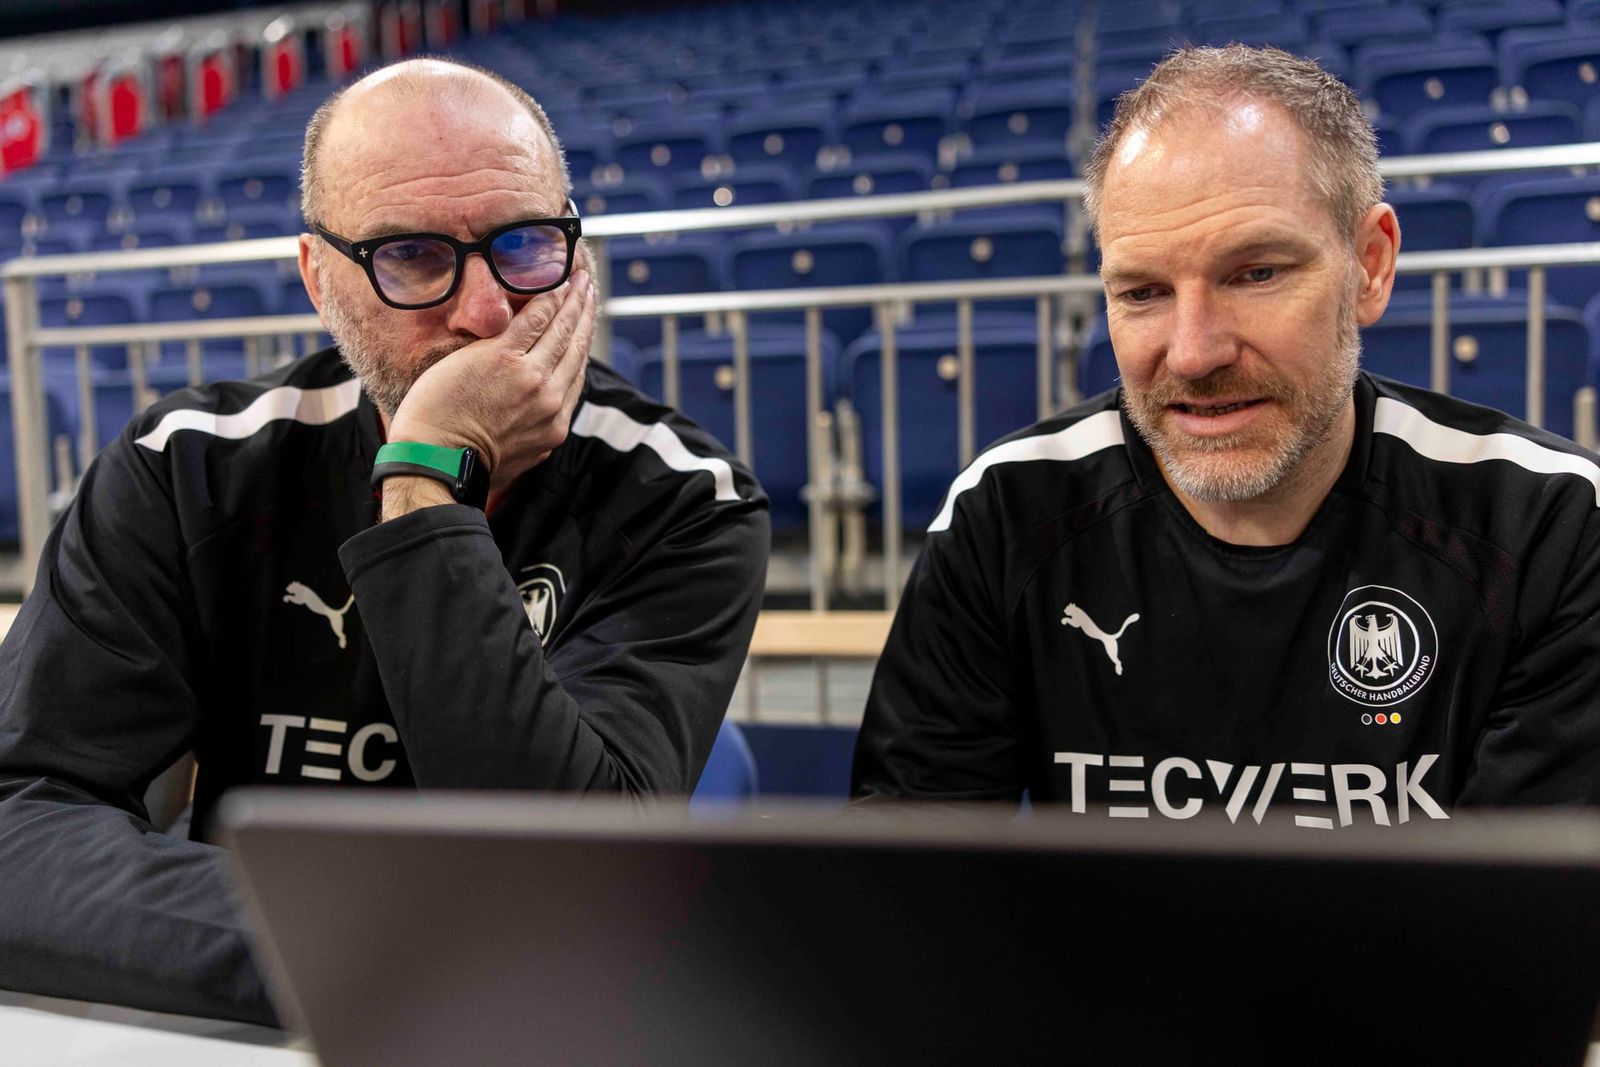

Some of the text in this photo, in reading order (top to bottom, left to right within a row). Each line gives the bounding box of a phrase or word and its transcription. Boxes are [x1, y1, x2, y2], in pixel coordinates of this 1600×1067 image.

[1331, 655, 1430, 701] DEUTSCHER HANDBALLBUND
[260, 714, 398, 782] TEC
[1054, 752, 1450, 830] TECWERK
